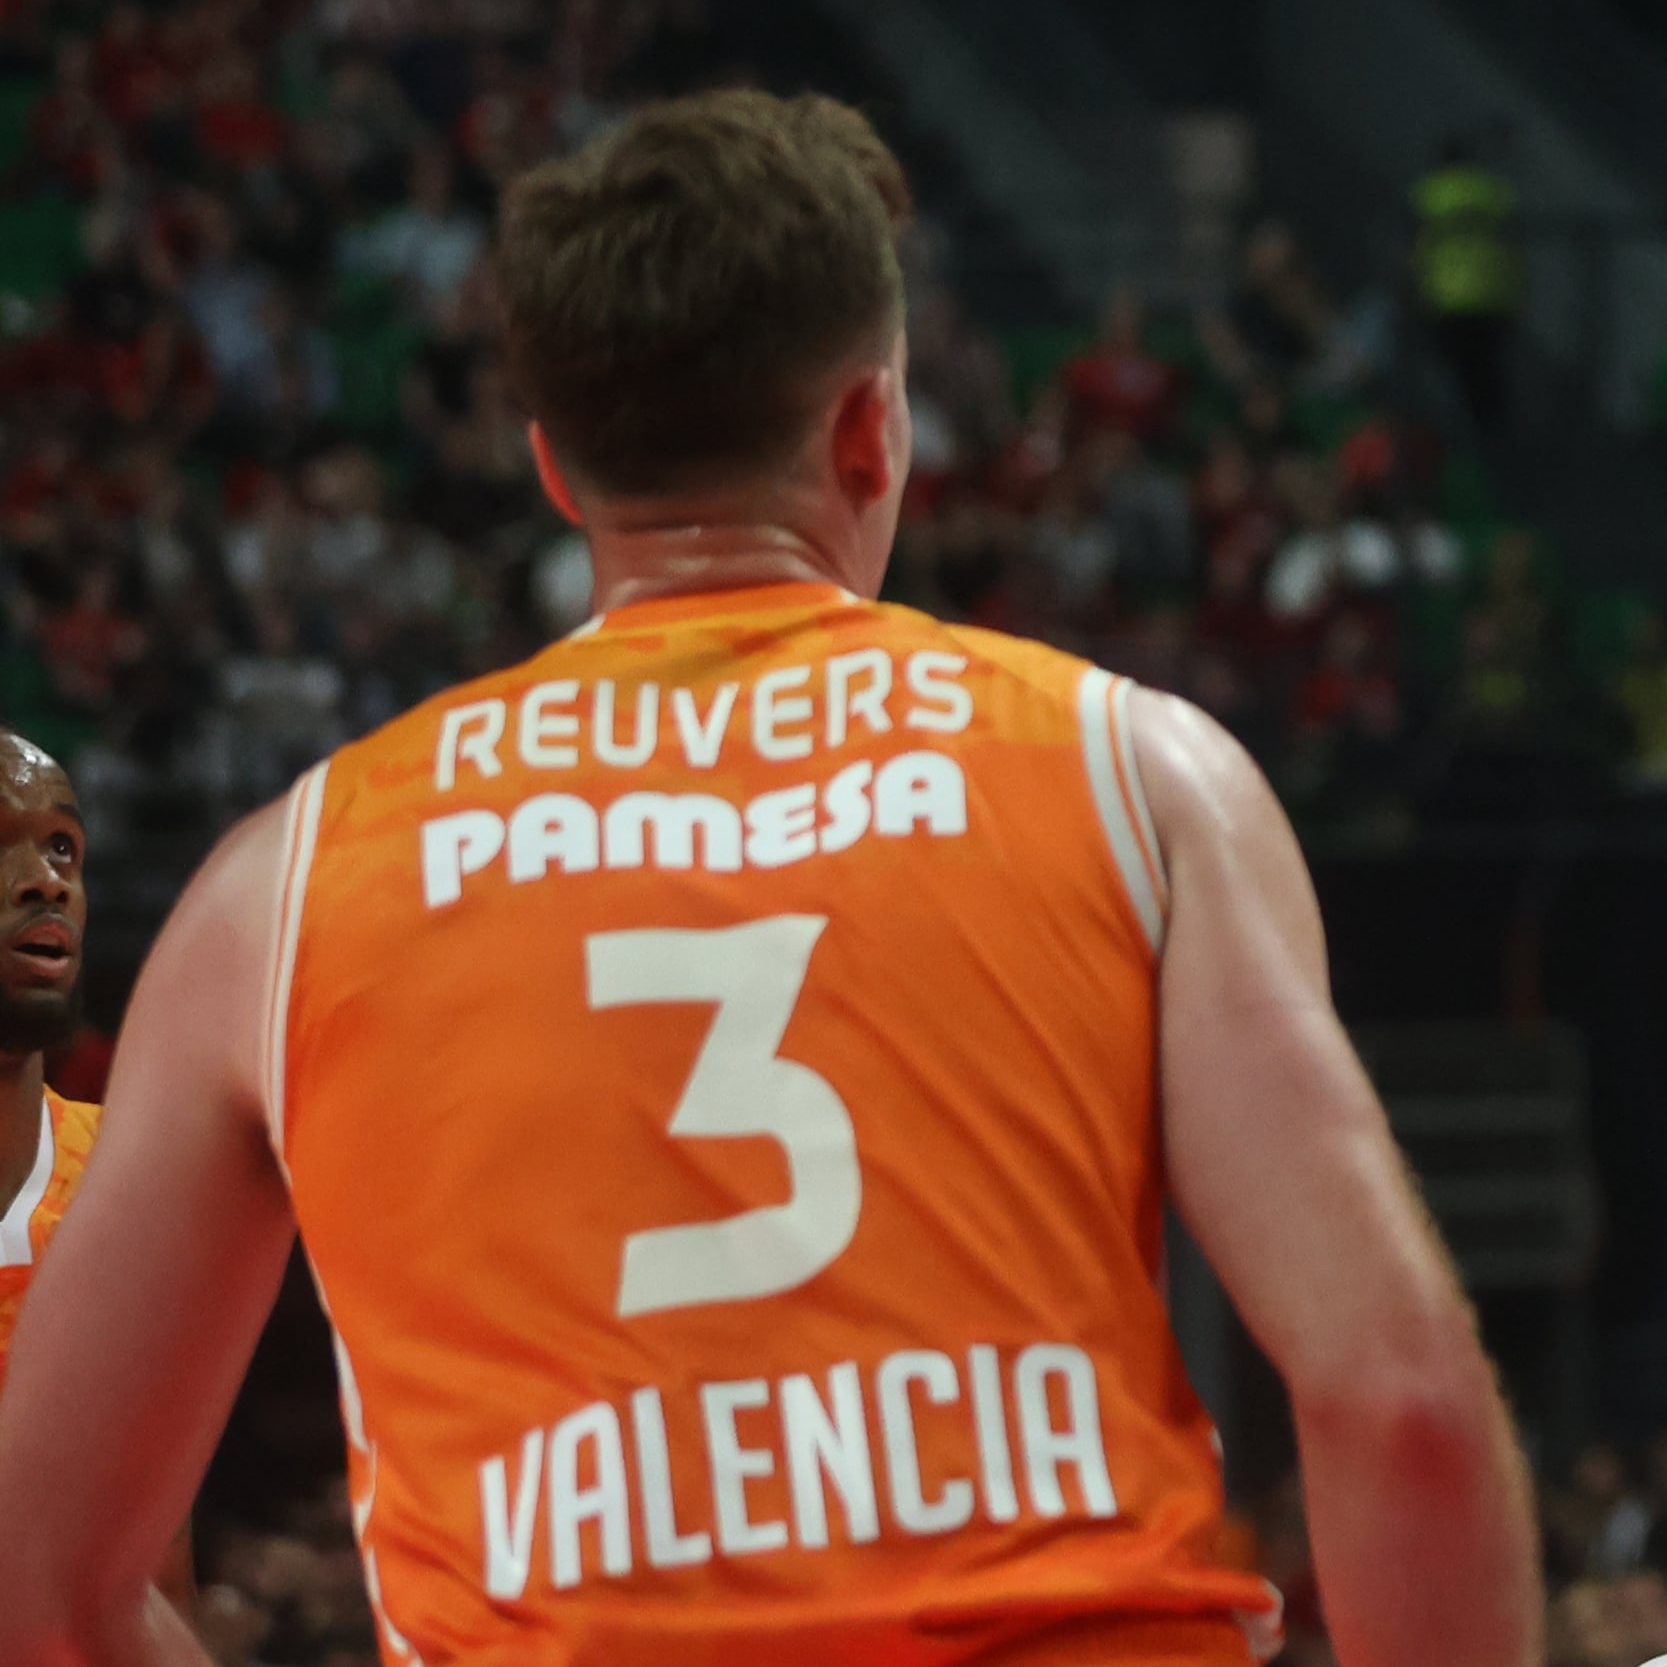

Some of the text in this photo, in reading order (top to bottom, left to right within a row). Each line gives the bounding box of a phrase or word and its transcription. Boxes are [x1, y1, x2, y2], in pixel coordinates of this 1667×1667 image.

[433, 647, 974, 792] REUVERS
[421, 750, 967, 909] PAMESA
[585, 914, 862, 1319] 3
[479, 1342, 1117, 1600] VALENCIA
